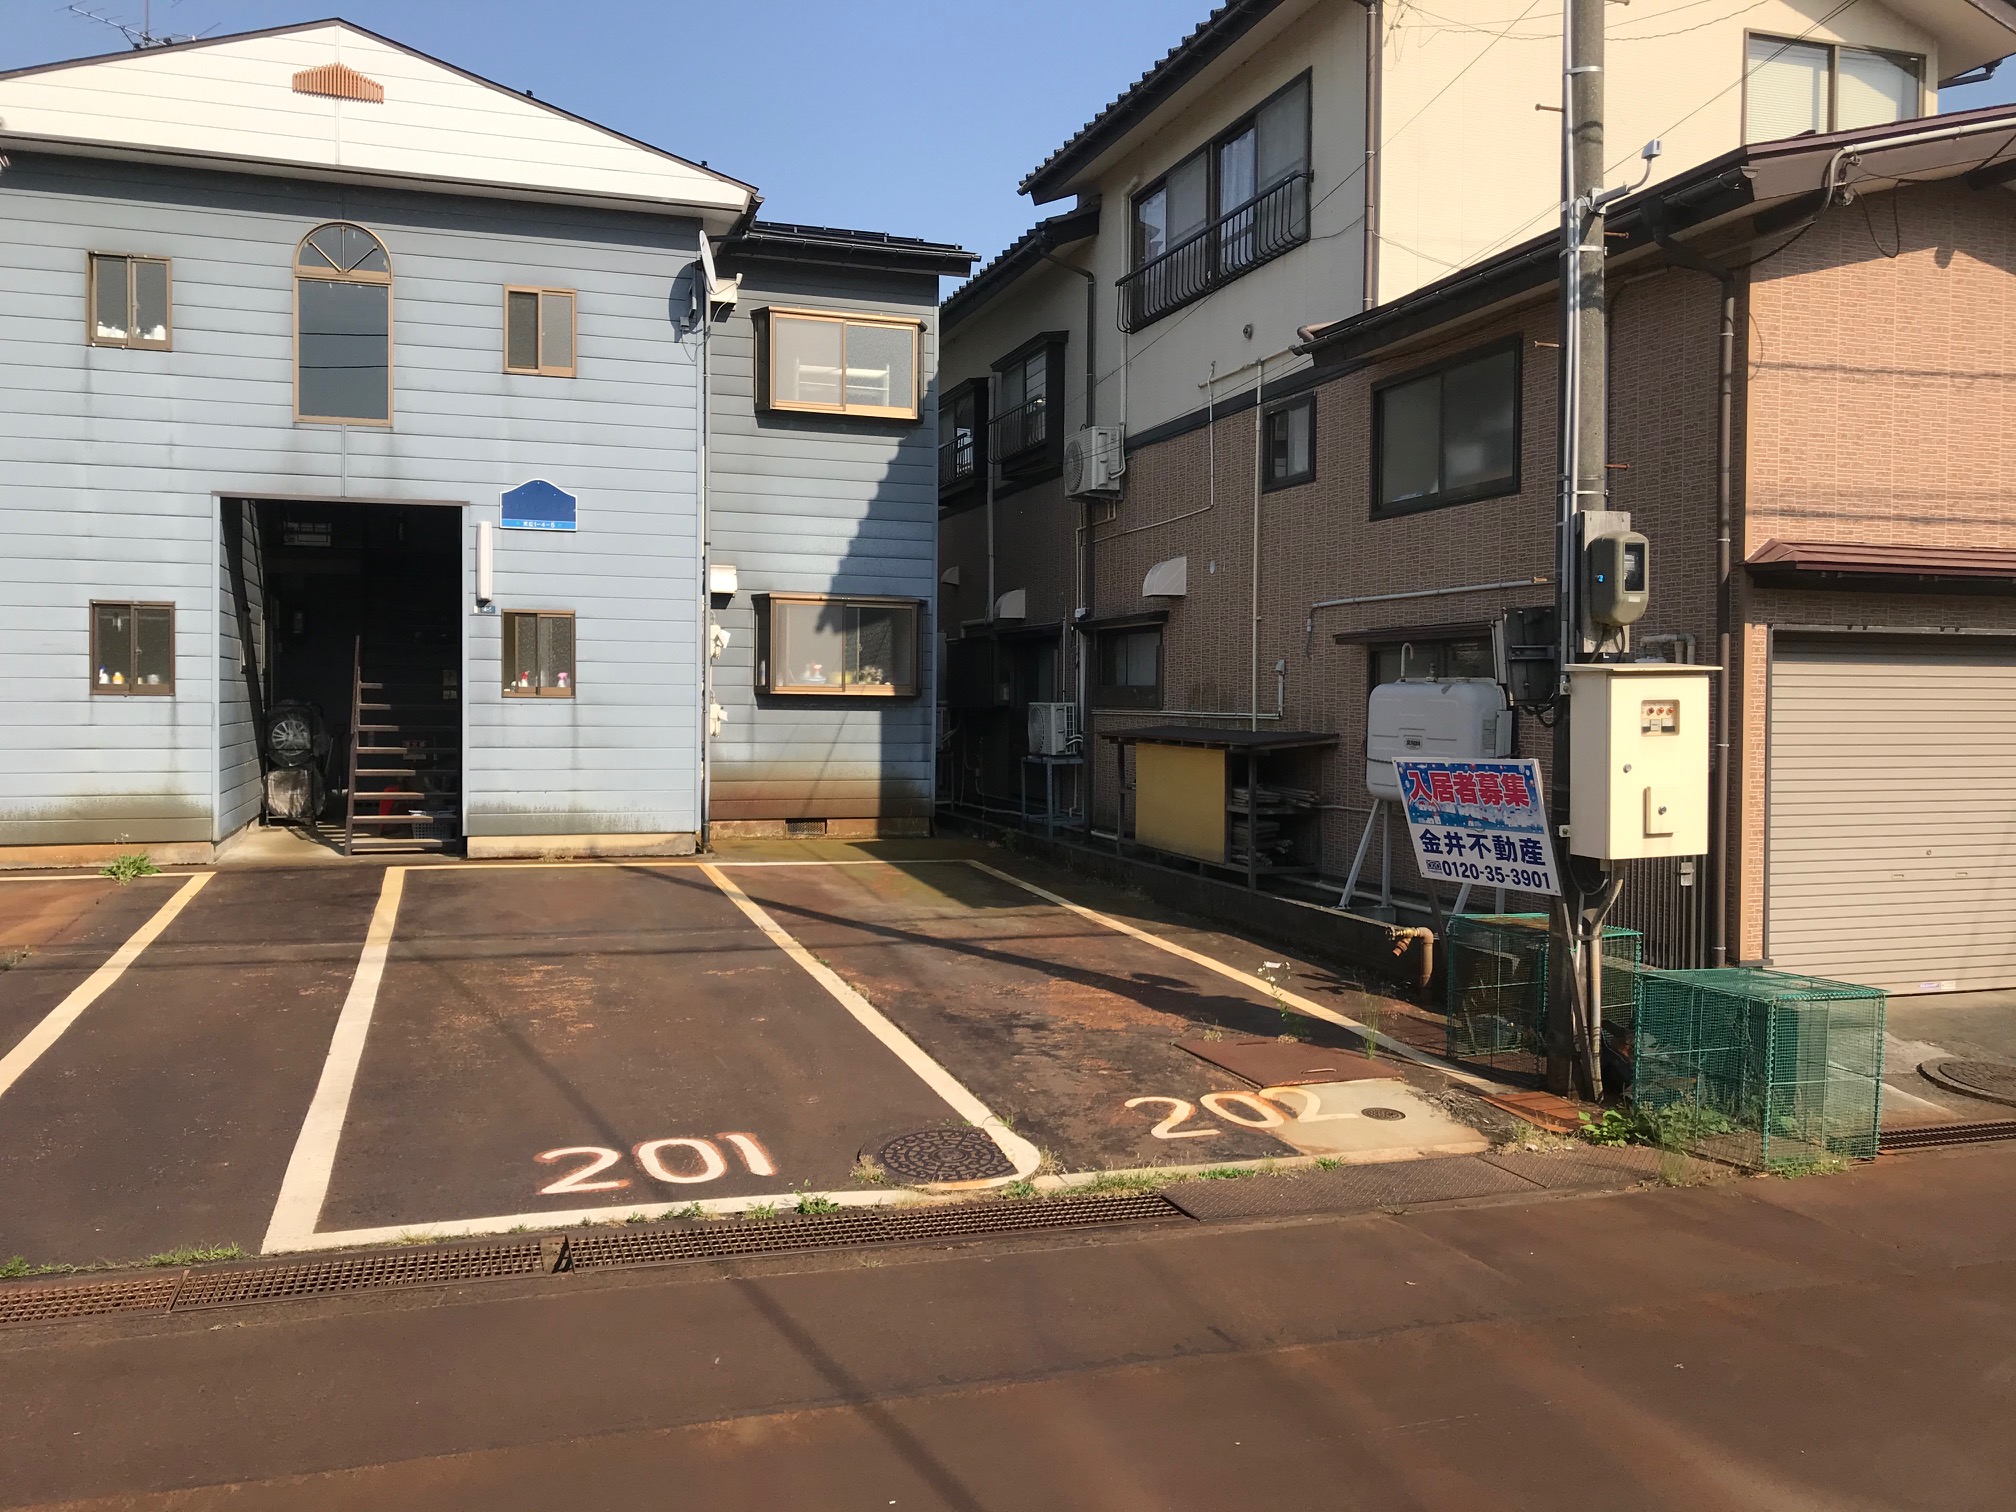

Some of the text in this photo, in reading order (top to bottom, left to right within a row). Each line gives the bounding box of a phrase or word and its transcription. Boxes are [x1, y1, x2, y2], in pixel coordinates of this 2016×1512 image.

[1407, 770, 1530, 807] 入居者募集
[1419, 829, 1546, 866] 金井不動産
[1442, 860, 1551, 890] 0120-35-3901
[1124, 1087, 1360, 1139] 202
[536, 1133, 776, 1194] 201
